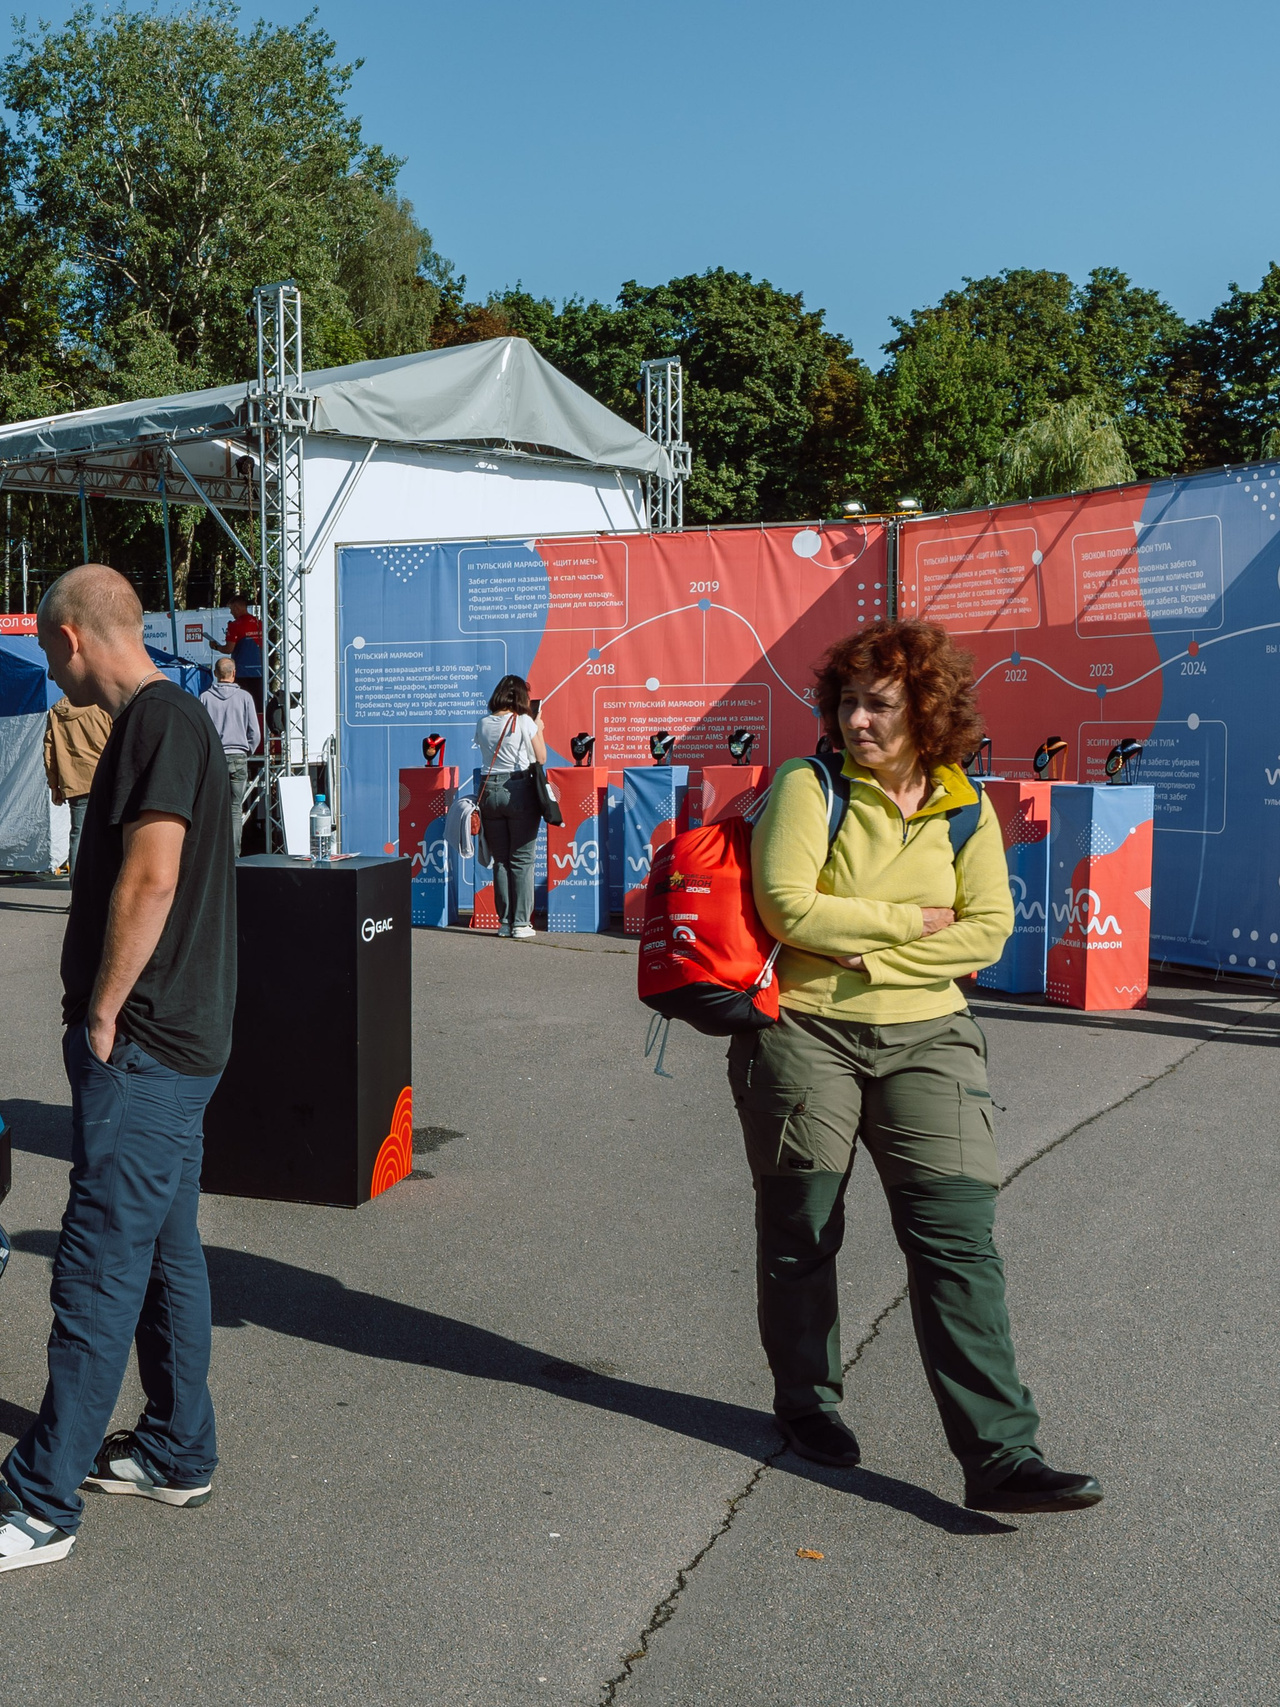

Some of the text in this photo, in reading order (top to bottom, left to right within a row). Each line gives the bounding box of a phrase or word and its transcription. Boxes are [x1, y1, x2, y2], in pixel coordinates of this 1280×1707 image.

[1155, 543, 1172, 552] ТУЛА
[476, 561, 511, 570] ТУЛЬСКИЙ
[514, 559, 548, 568] МАРАФОН
[553, 558, 571, 568] «ЩИТ
[580, 558, 598, 566] МЕЧ»
[468, 585, 545, 593] масштабного проекта
[689, 581, 719, 592] 2019
[532, 602, 571, 611] дистанции
[572, 601, 586, 609] для
[588, 600, 623, 609] взрослых
[468, 613, 508, 622] участников
[516, 610, 537, 620] детей
[354, 650, 423, 660] ТУЛЬСКИЙ МАРАФОН
[354, 666, 382, 675] История
[458, 665, 474, 673] году
[475, 664, 491, 673] Тула
[586, 664, 615, 675] 2018
[1089, 663, 1114, 677] 2023
[1180, 662, 1207, 676] 2024
[376, 675, 404, 684] увидела
[406, 673, 448, 681] масштабное
[1004, 669, 1027, 682] 2022
[428, 681, 458, 691] который
[364, 693, 405, 701] проводился
[413, 692, 437, 700] городе
[438, 692, 460, 700] целых
[355, 700, 392, 710] Пробежать
[393, 701, 410, 709] одну
[437, 699, 474, 709] дистанций
[629, 700, 666, 708] ТУЛЬСКИЙ
[668, 699, 705, 708] МАРАФОН
[648, 715, 682, 725] марафон
[703, 716, 726, 724] одним
[604, 726, 625, 734] ярких
[627, 725, 672, 734] спортивных
[708, 725, 724, 733] года
[604, 753, 646, 761] участников
[553, 878, 587, 886] ТУЛЬСКИЙ
[376, 918, 393, 933] GAC
[1052, 936, 1122, 950] ТУЛЬСКИЙ МАРАФОН
